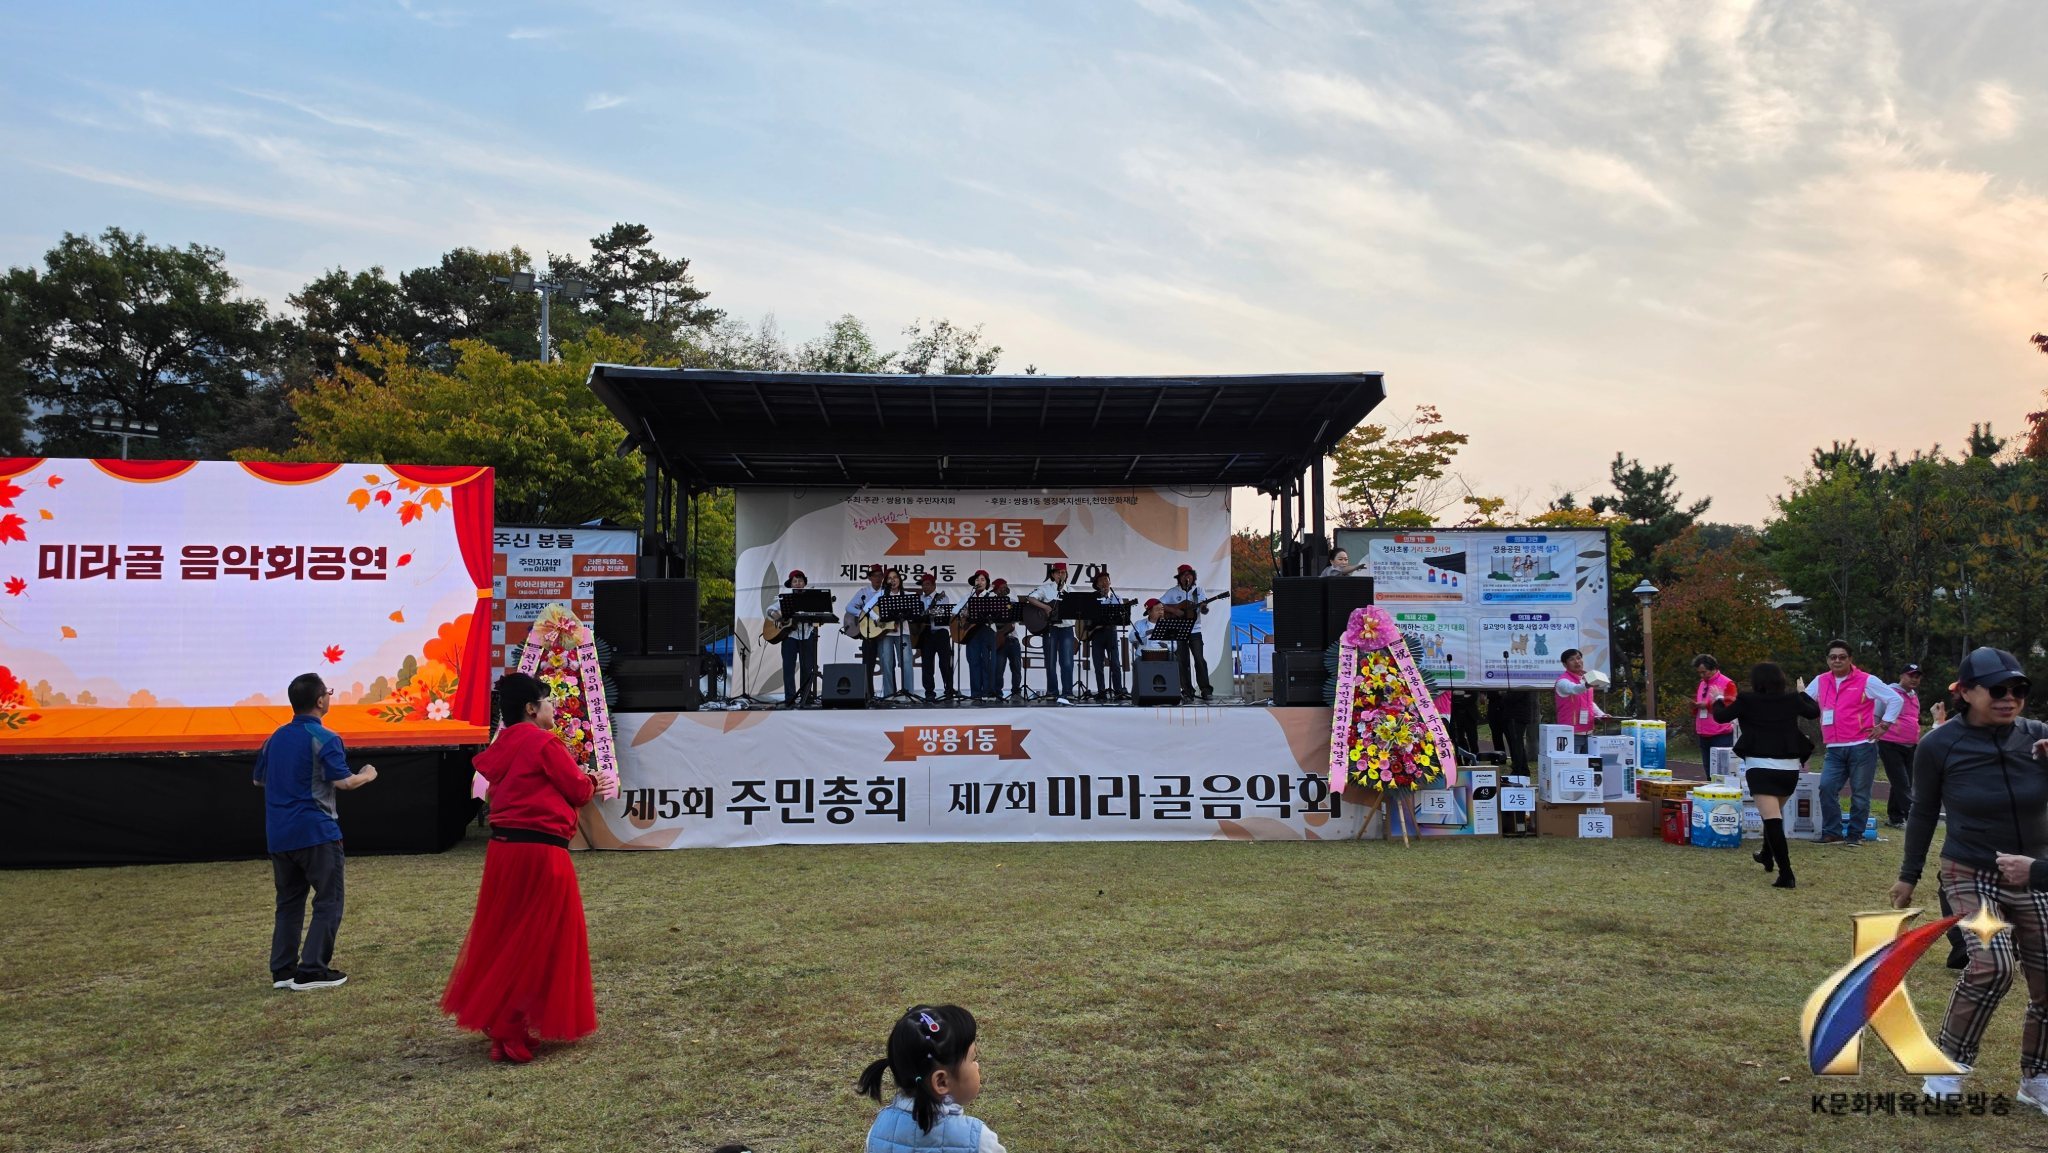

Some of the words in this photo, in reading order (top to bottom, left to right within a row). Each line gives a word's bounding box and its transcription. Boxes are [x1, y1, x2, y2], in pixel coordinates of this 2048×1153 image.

[886, 496, 914, 504] 쌍용1동
[916, 496, 956, 504] 주민자치회
[991, 497, 1007, 505] 후원
[1013, 497, 1041, 505] 쌍용1동
[493, 533, 530, 548] 주신
[537, 533, 575, 549] 분들
[926, 522, 1026, 549] 쌍용1동
[38, 544, 164, 580] 미라골
[180, 545, 387, 581] 음악회공연
[519, 558, 561, 566] 주민자치회
[581, 652, 596, 661] 祝
[1395, 648, 1411, 661] 祝
[917, 728, 997, 753] 쌍용1동
[1569, 774, 1587, 787] 4등
[1480, 788, 1490, 796] 43
[620, 786, 713, 820] 제5회
[726, 776, 906, 826] 주민총회
[947, 781, 1036, 815] 제7회
[1430, 796, 1446, 809] 1등
[1509, 794, 1527, 805] 2등
[1587, 821, 1605, 833] 3등
